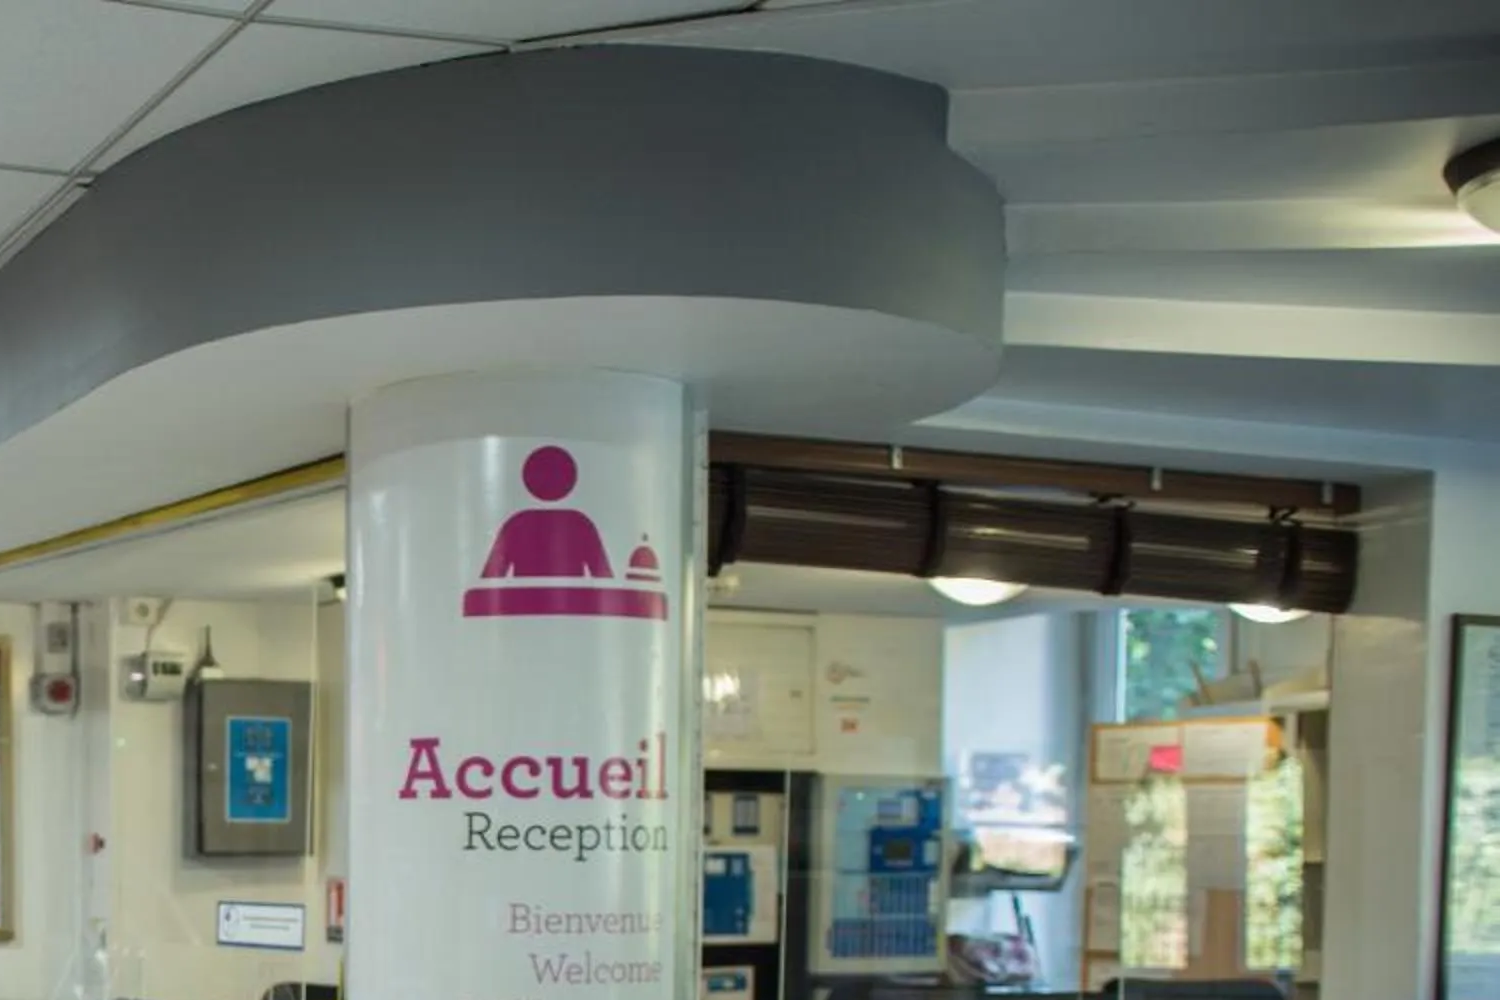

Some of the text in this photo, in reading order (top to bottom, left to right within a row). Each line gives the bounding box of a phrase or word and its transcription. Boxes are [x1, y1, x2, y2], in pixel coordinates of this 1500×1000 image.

[399, 732, 668, 800] Accueil
[463, 812, 668, 862] Reception
[507, 902, 664, 935] Bienvenue
[528, 949, 663, 985] Welcome
